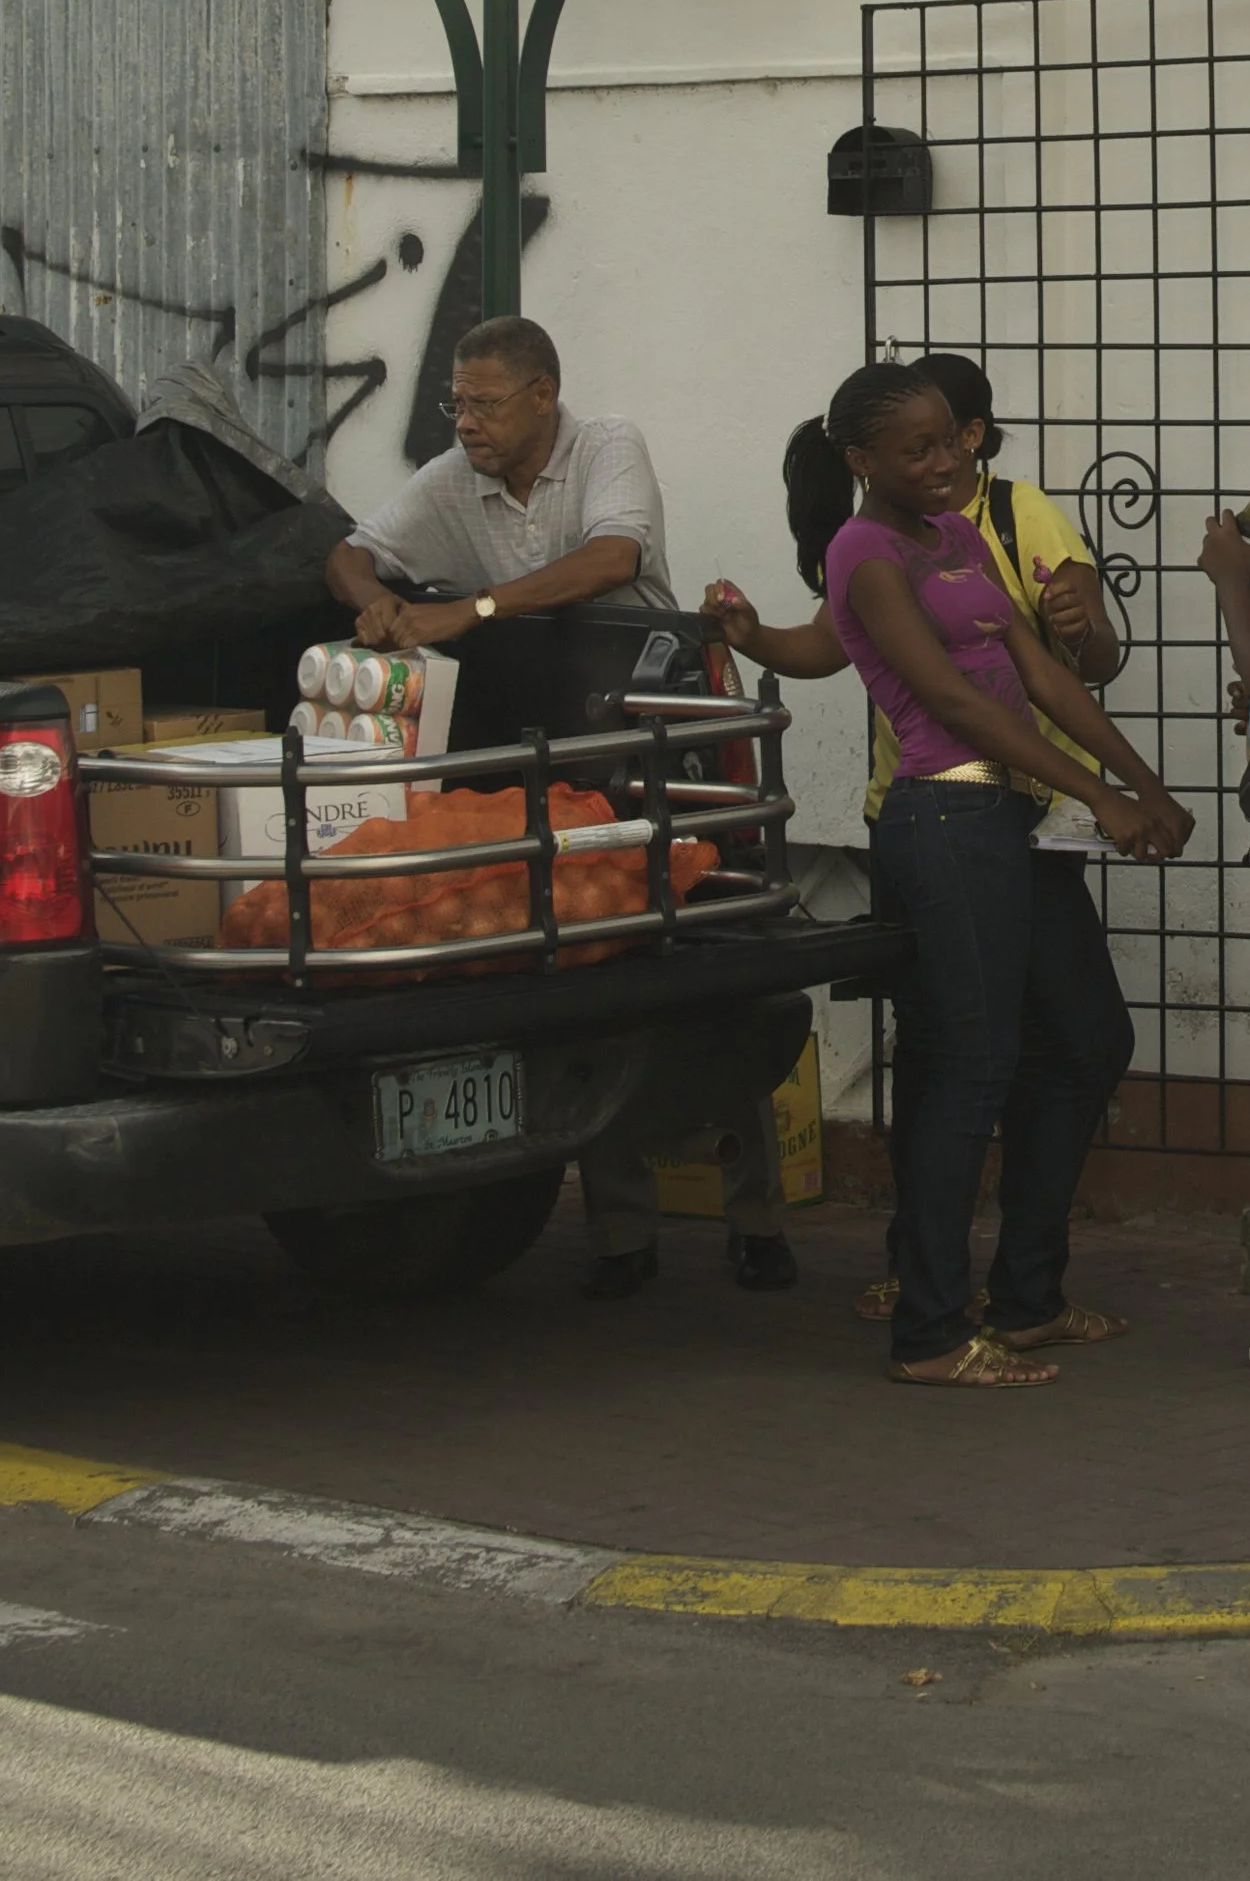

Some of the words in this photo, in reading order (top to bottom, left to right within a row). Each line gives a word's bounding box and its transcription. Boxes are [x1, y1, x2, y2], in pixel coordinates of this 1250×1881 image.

[305, 791, 372, 822] NDRÉ
[399, 1089, 414, 1140] P
[445, 1071, 513, 1129] 4810
[779, 1119, 818, 1160] OGNE
